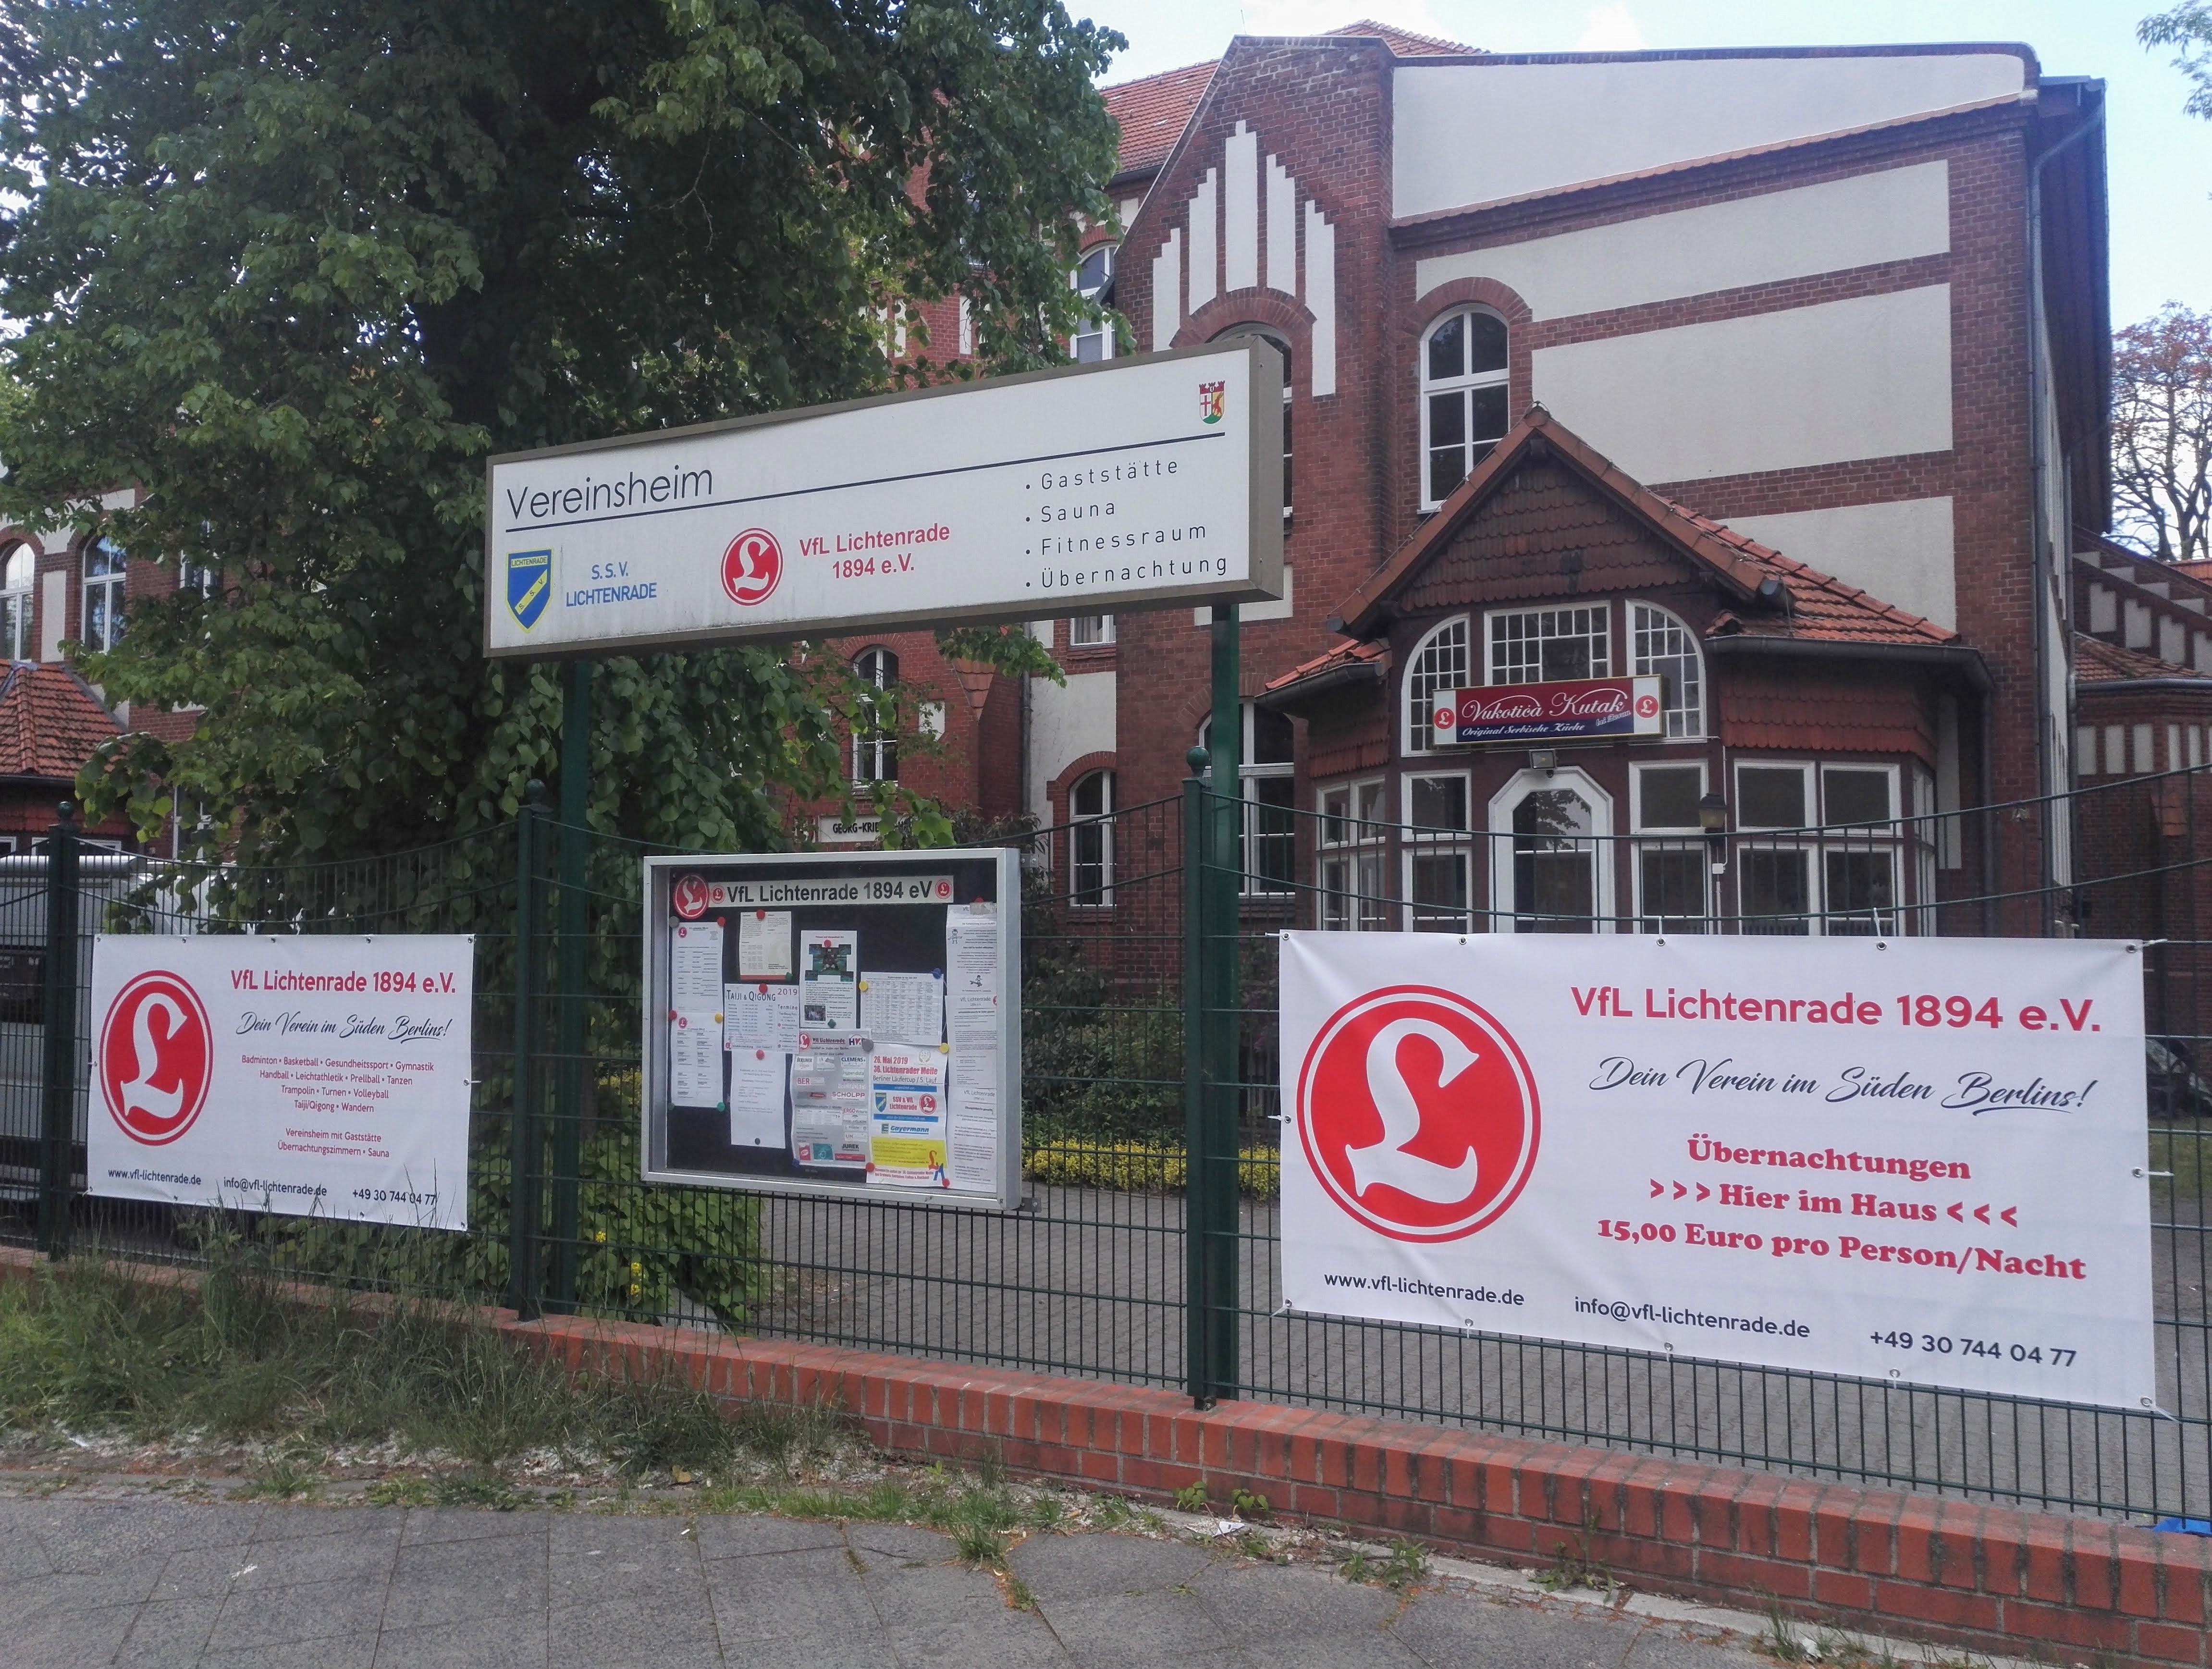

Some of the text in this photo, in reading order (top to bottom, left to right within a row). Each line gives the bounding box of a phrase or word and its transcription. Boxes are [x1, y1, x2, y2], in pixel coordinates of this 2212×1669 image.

[1041, 460, 1178, 490] Gaststätte
[506, 464, 713, 520] Vereinsheim
[1041, 503, 1115, 523] Sauna
[799, 523, 950, 557] VfL Lichtenrade
[1042, 525, 1205, 555] Fitnessraum
[511, 557, 547, 567] LICHTENRADE
[832, 552, 915, 579] 1894 e.V.
[1042, 557, 1227, 588] Übernachtung
[565, 582, 658, 607] LICHTENRADE
[1548, 688, 1628, 716] Kutak
[1462, 722, 1585, 737] Original Serbische Küche
[727, 885, 754, 903] VfL
[760, 884, 859, 902] Lichtenrade
[863, 881, 904, 900] 1894
[909, 880, 933, 899] eV
[231, 969, 456, 993] VfL Lichtenrade 1894 e.V.
[777, 988, 798, 996] 2019
[749, 991, 776, 1001] QIGONG
[1570, 985, 2101, 1033] VfL Lichtenrade 1894 e.V.
[236, 1011, 453, 1041] Dein Verein im Süden Berlins!
[242, 1055, 434, 1072] Badminton Basketball Gesundheitssport Gymnastik
[883, 1066, 920, 1074] Lichtenrader
[921, 1067, 938, 1075] Meile
[893, 1056, 908, 1065] 2019
[259, 1070, 413, 1085] Handball Leichtathletik Prellball Tanzen
[892, 1076, 916, 1084] Läufercup
[1588, 1056, 2097, 1110] Dein Verein im Süden Berlins!
[281, 1084, 389, 1100] Trampolin Turnen Volleyball
[294, 1099, 374, 1113] Taiji/Qigong Wandern
[286, 1128, 382, 1142] Vereinsheim mit Gaststätte
[277, 1139, 390, 1158] Übernachtungszimmern Sauna
[1687, 1133, 1972, 1182] Übernachtungen
[108, 1168, 201, 1185] www.vfl-lichtenrade.de
[352, 1189, 371, 1200] +49
[373, 1189, 387, 1201] 30
[389, 1190, 406, 1203] 744
[409, 1192, 422, 1204] 04
[425, 1194, 436, 1205] 77
[1718, 1183, 1938, 1222] Hier im Haus
[1598, 1218, 2087, 1281] 15,00 Euro pro Person/Nacht
[1324, 1272, 2077, 1368] www.vfl-lichtenrade.de info@vfl-lichtenrade.de +49 30 744 04 77
